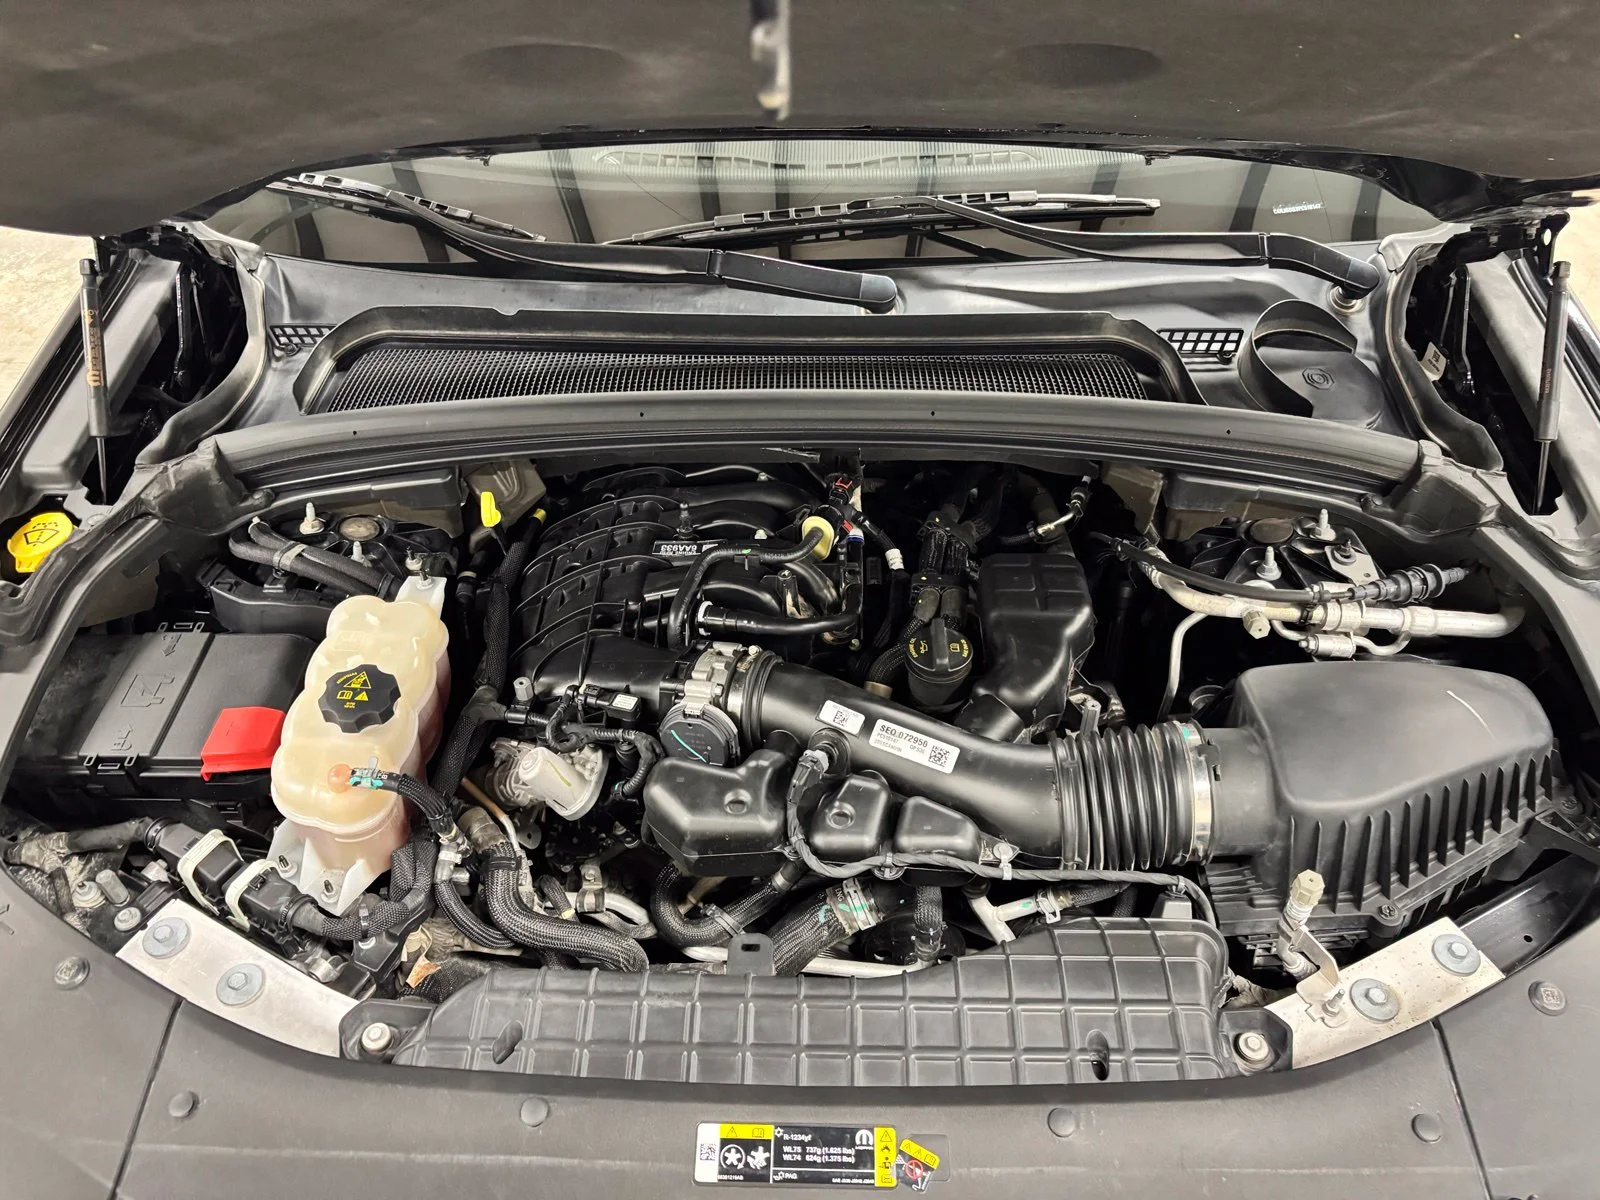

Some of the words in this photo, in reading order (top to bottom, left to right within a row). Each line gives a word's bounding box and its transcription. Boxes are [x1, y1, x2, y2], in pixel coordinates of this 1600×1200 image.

[783, 1133, 812, 1142] R-1234yf
[782, 1146, 802, 1154] WL75
[782, 1154, 802, 1162] WL74
